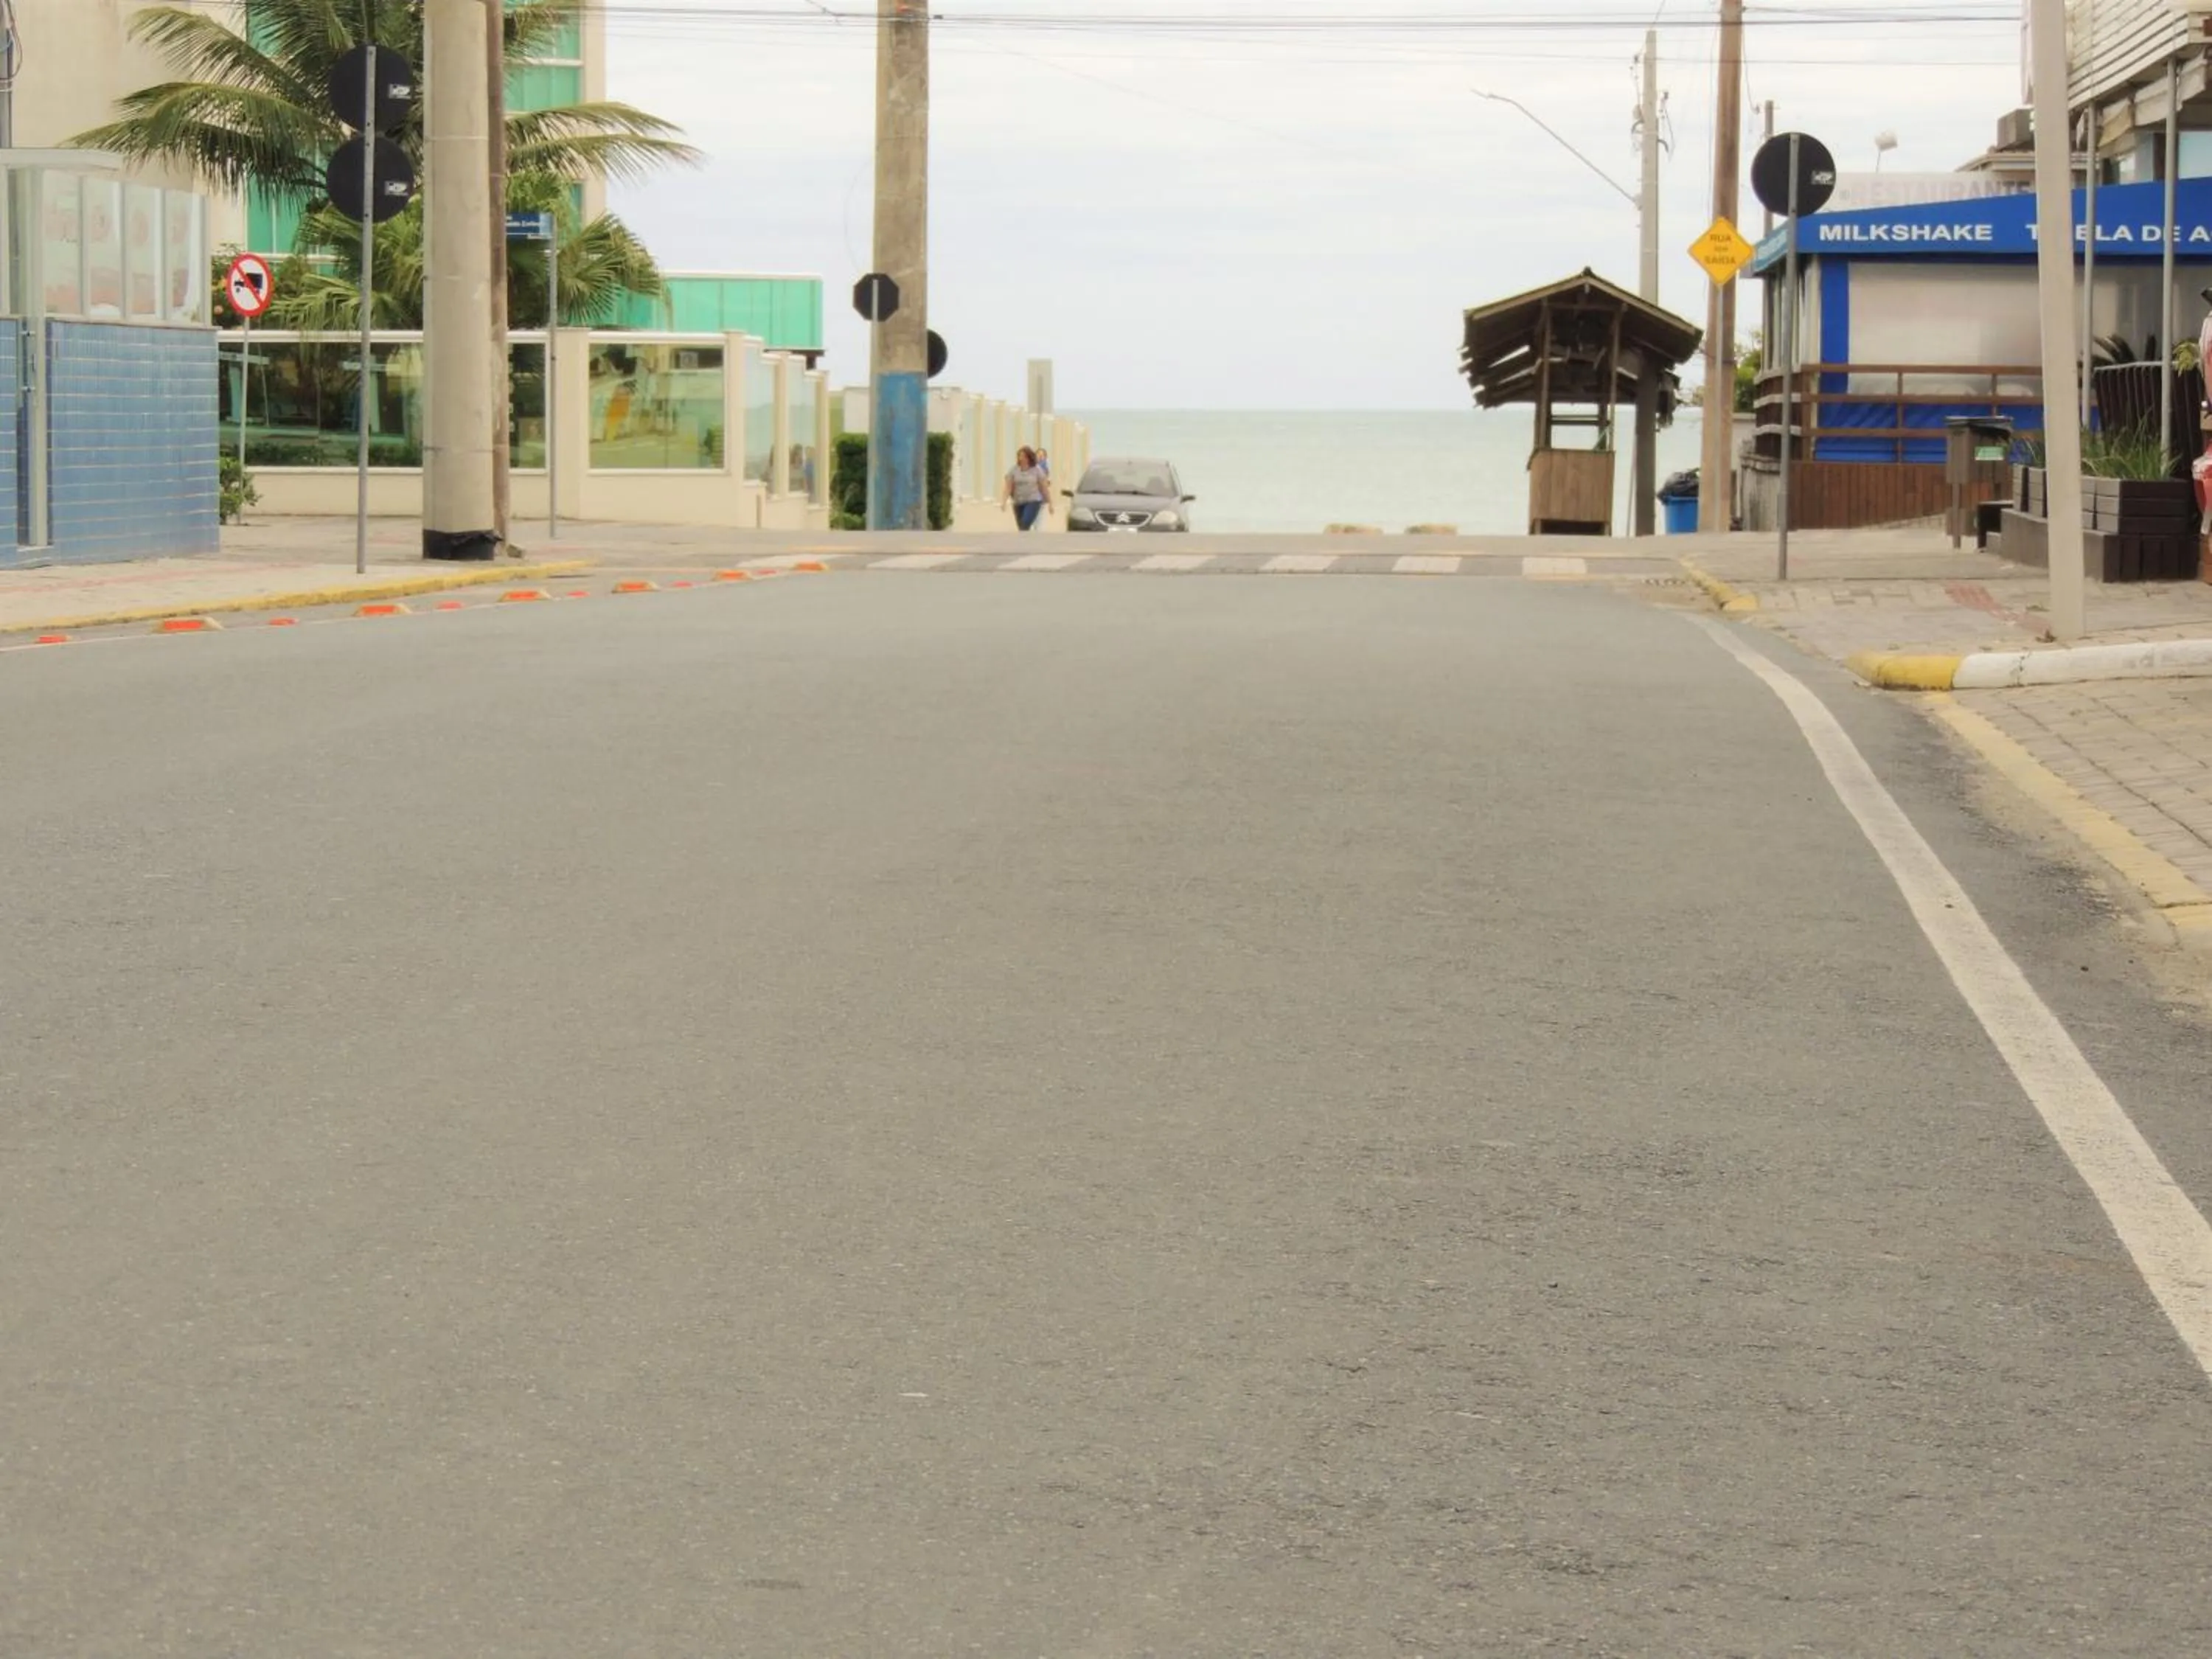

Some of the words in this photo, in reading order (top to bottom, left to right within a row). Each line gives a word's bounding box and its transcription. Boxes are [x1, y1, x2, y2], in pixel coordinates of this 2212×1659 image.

[1818, 223, 1993, 241] MILKSHAKE
[2025, 223, 2134, 242] TELA
[2188, 226, 2212, 242] A
